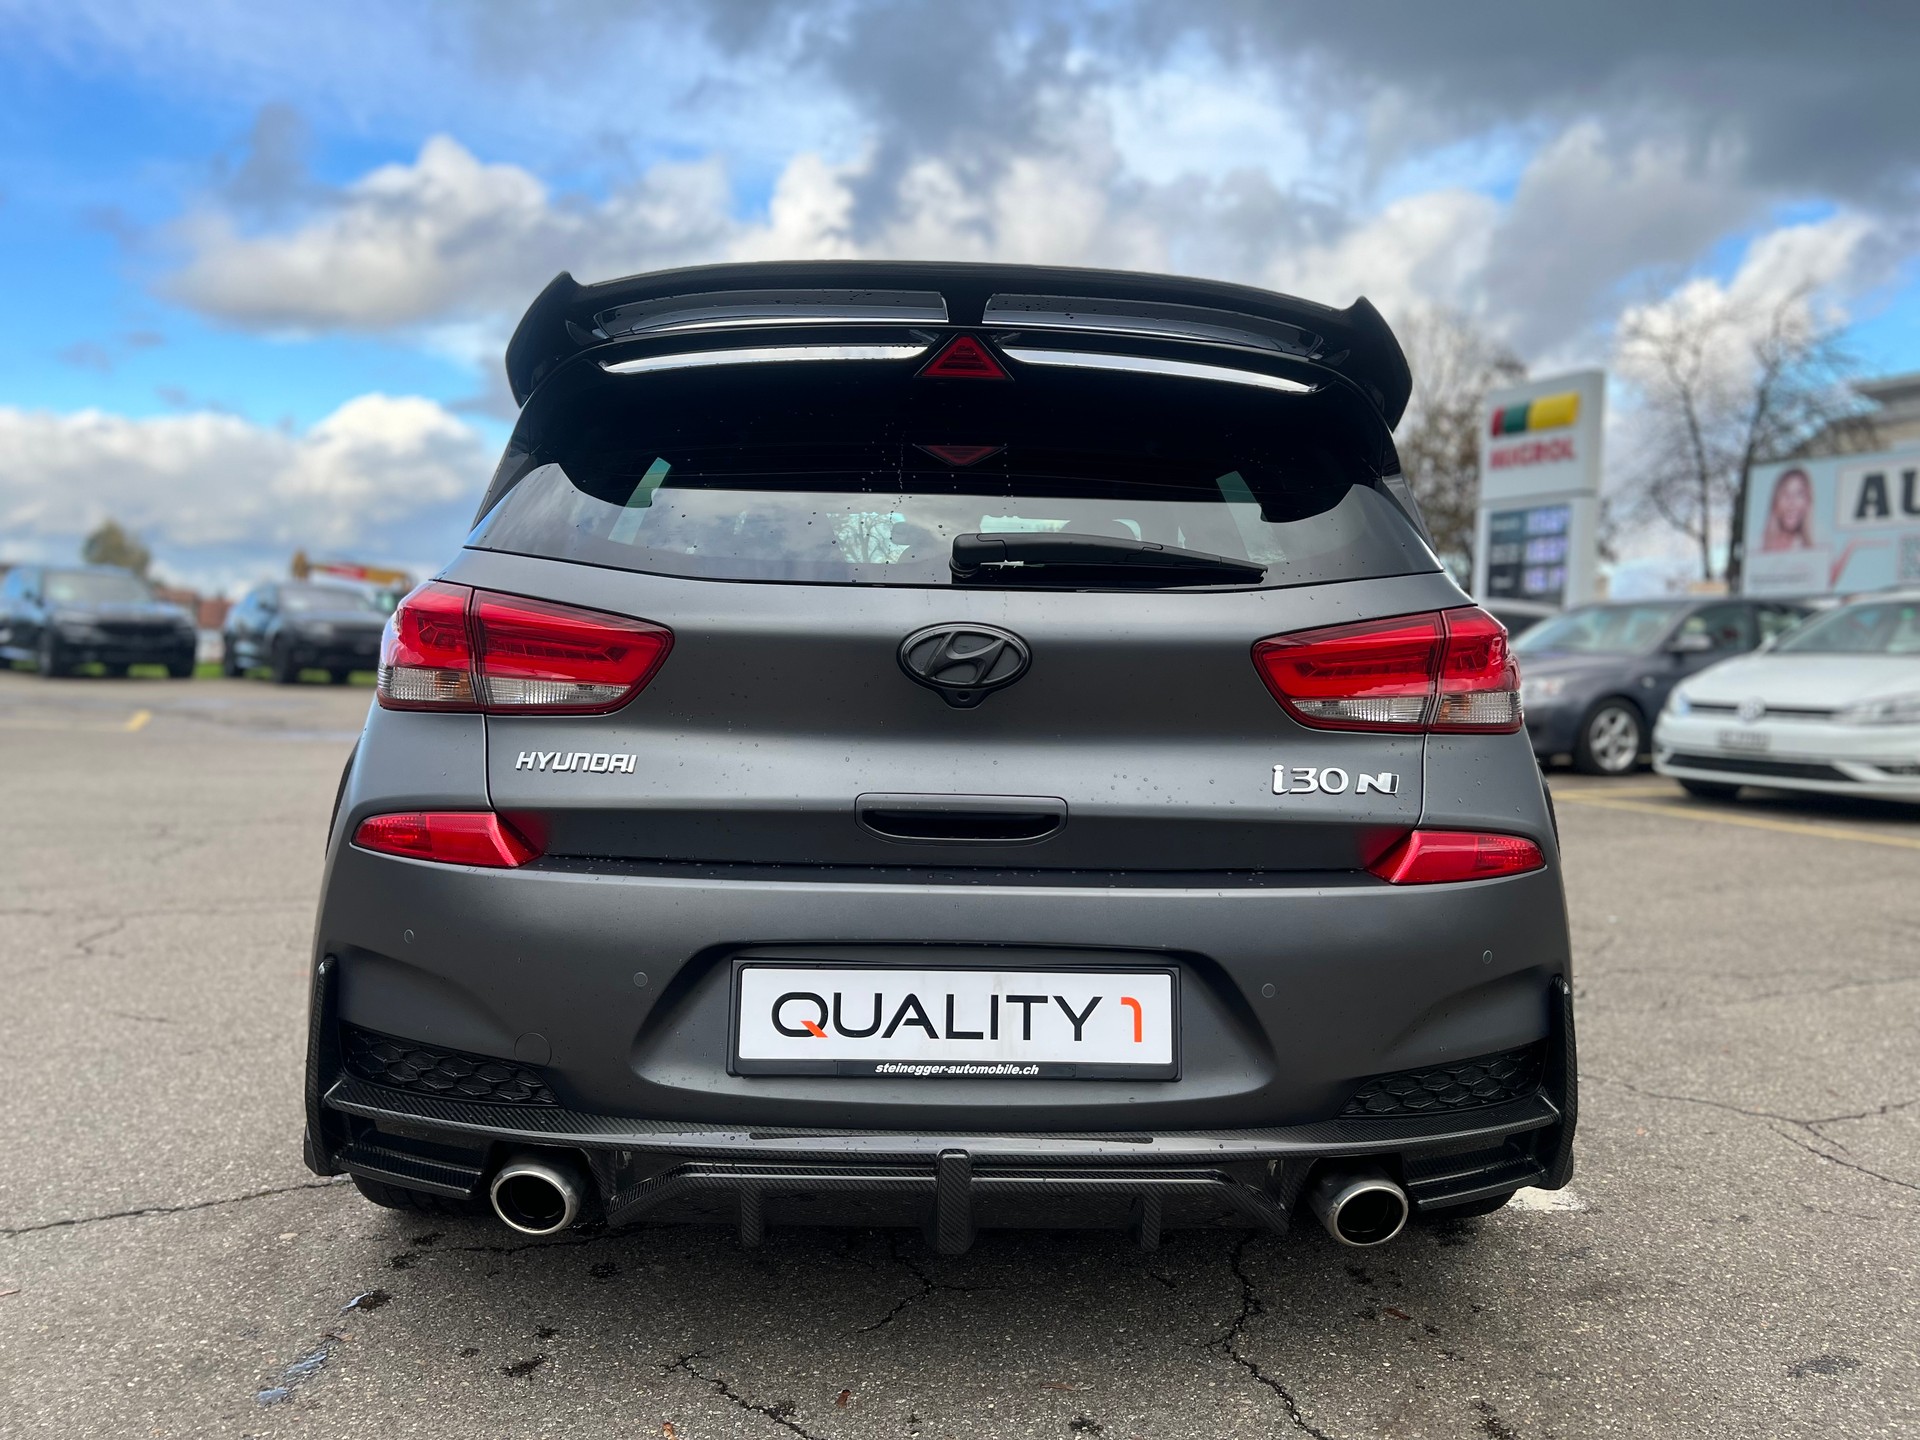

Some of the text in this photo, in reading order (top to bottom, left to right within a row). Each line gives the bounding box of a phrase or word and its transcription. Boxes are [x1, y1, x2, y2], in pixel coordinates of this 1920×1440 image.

[515, 751, 637, 774] HYUNDAI
[1272, 764, 1349, 794] i30
[771, 991, 1143, 1043] QUALITY 1
[874, 1062, 1039, 1076] steinegger-automobile.ch
